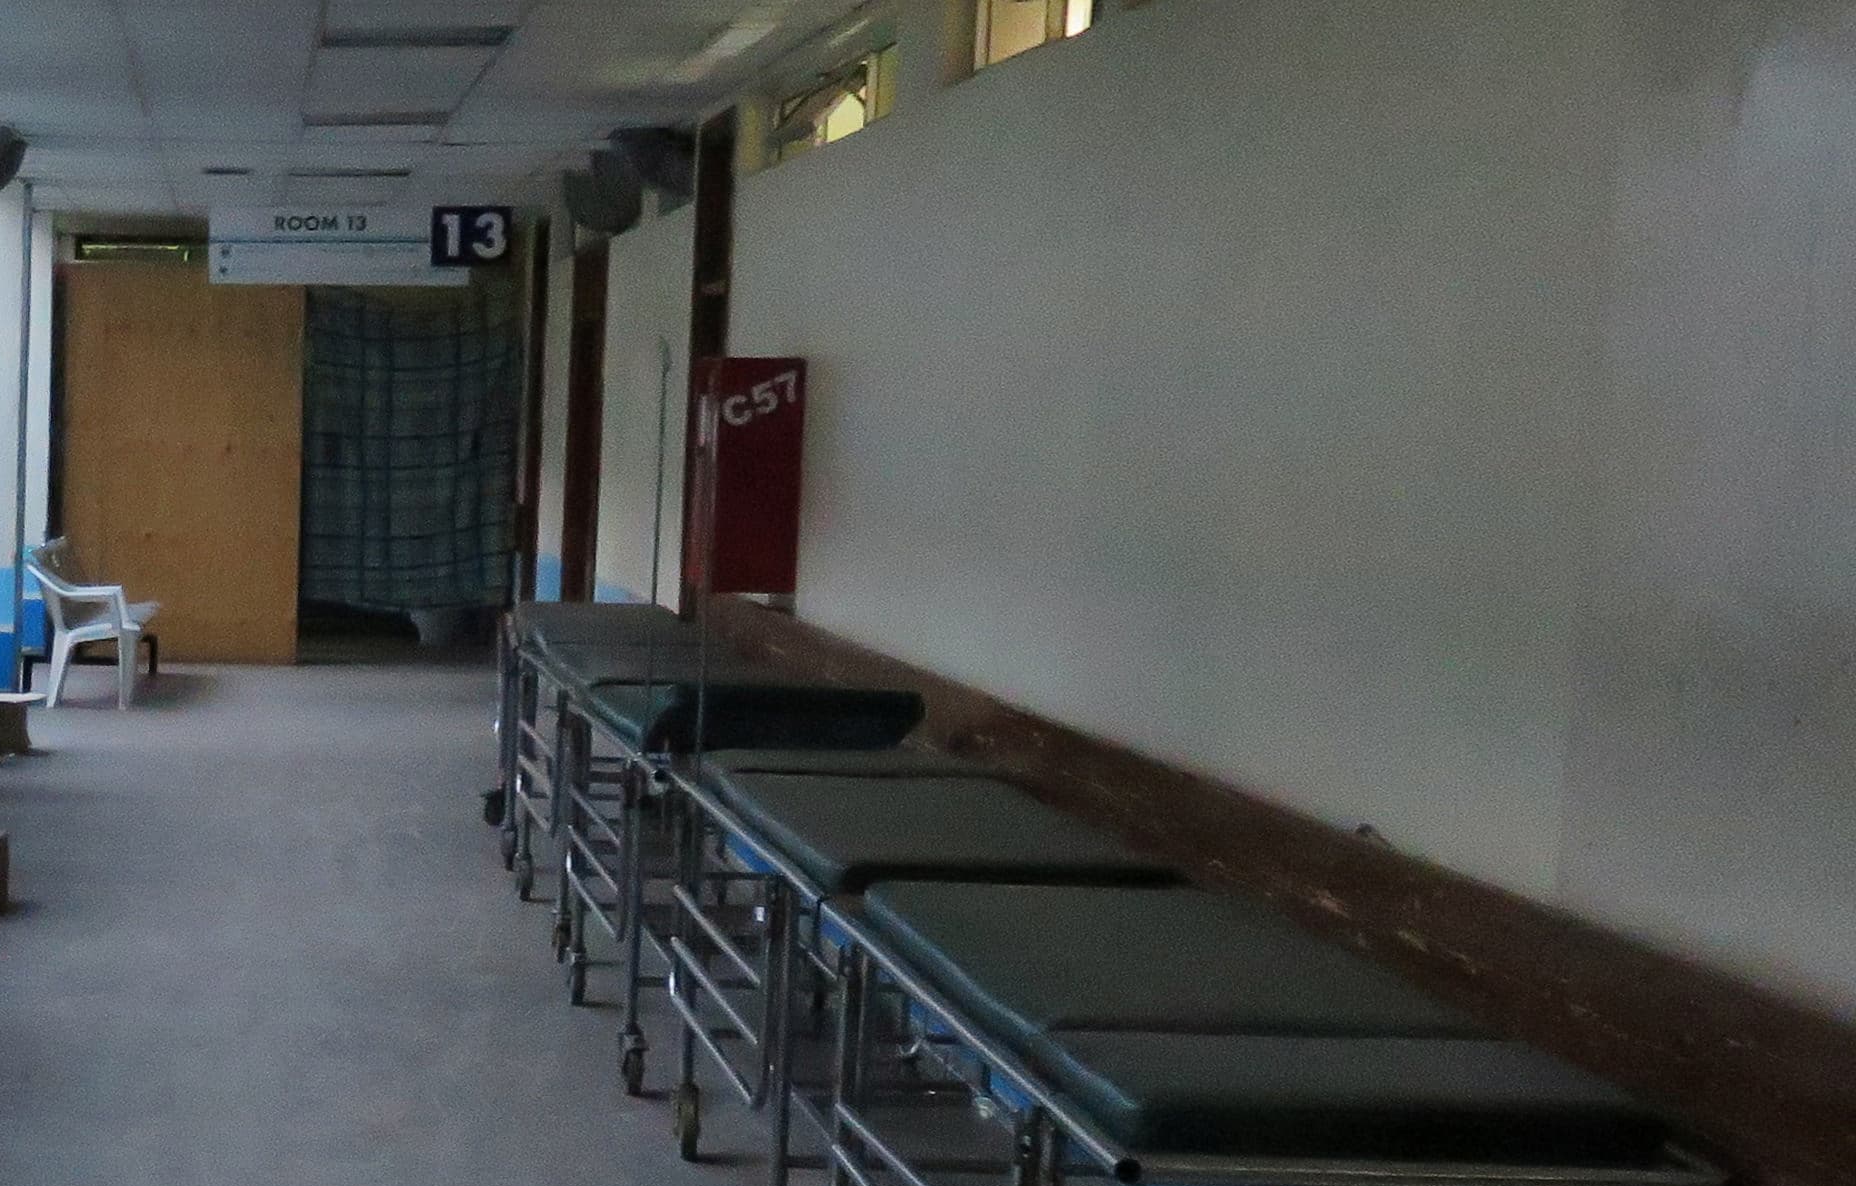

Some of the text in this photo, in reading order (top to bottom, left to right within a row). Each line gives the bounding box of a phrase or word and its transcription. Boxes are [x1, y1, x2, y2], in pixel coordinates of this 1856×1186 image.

[274, 215, 368, 231] ROOM 13
[442, 212, 506, 259] 13
[722, 370, 798, 426] C57
